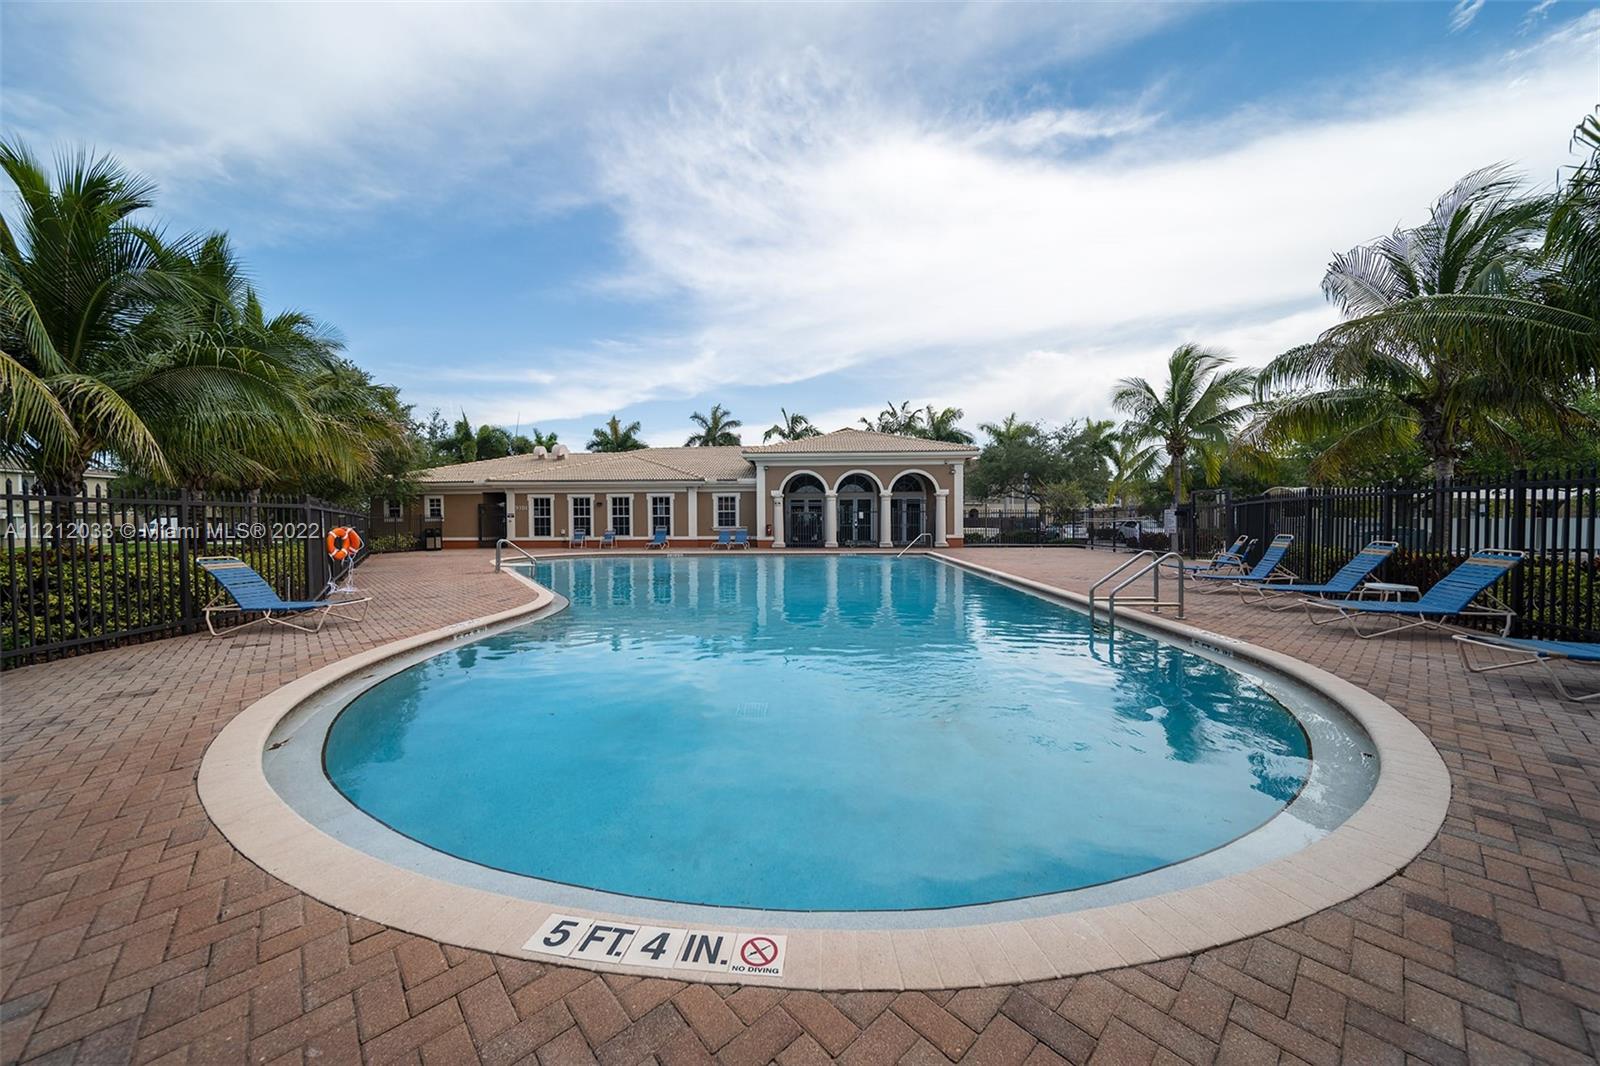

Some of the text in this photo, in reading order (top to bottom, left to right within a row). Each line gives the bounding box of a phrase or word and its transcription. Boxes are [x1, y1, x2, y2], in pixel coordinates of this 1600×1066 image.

[543, 920, 728, 965] 5 FT. 4 IN.
[747, 966, 779, 974] DIVING
